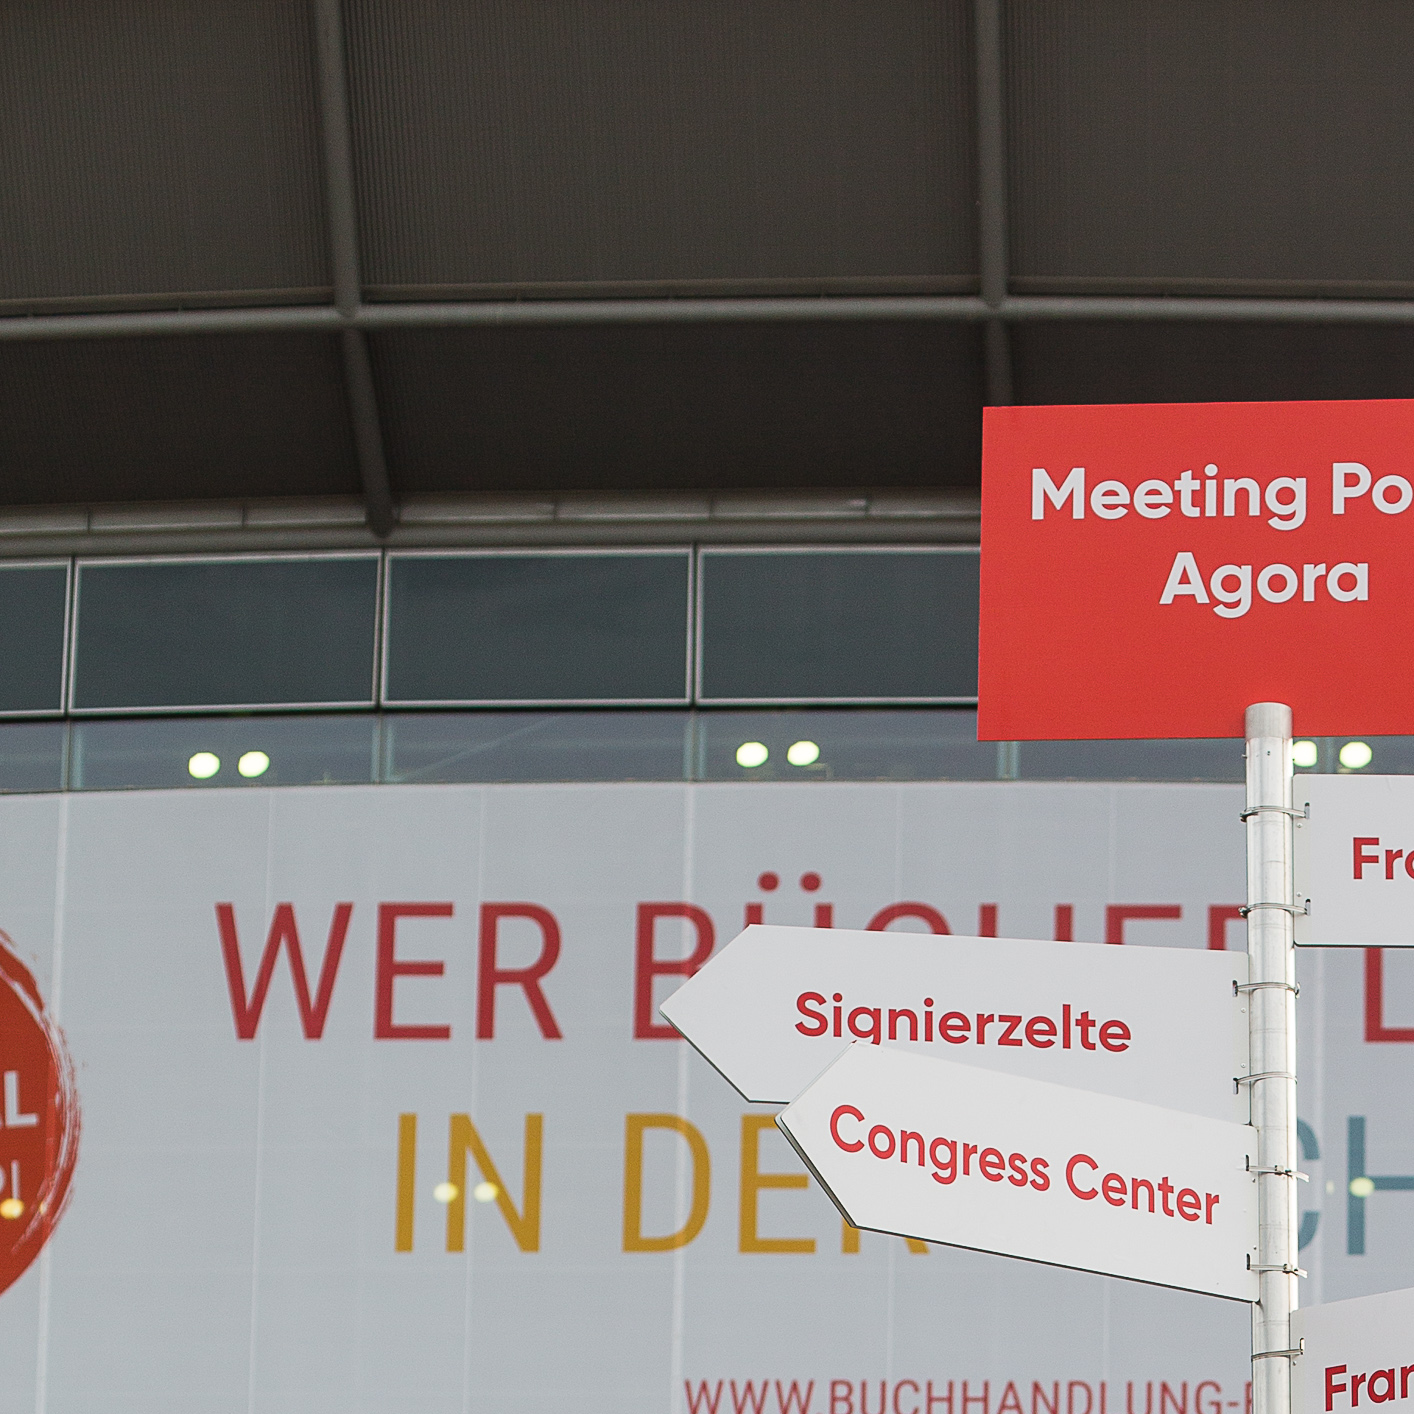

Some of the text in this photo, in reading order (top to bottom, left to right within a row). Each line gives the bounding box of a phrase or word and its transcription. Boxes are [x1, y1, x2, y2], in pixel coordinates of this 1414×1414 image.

[1031, 462, 1307, 531] Meeting
[1159, 551, 1369, 619] Agora
[215, 901, 563, 1041] WER
[794, 991, 1132, 1053] Signierzelte
[394, 1112, 545, 1254] IN
[621, 1112, 930, 1254] DE
[829, 1104, 1220, 1225] Congress Center
